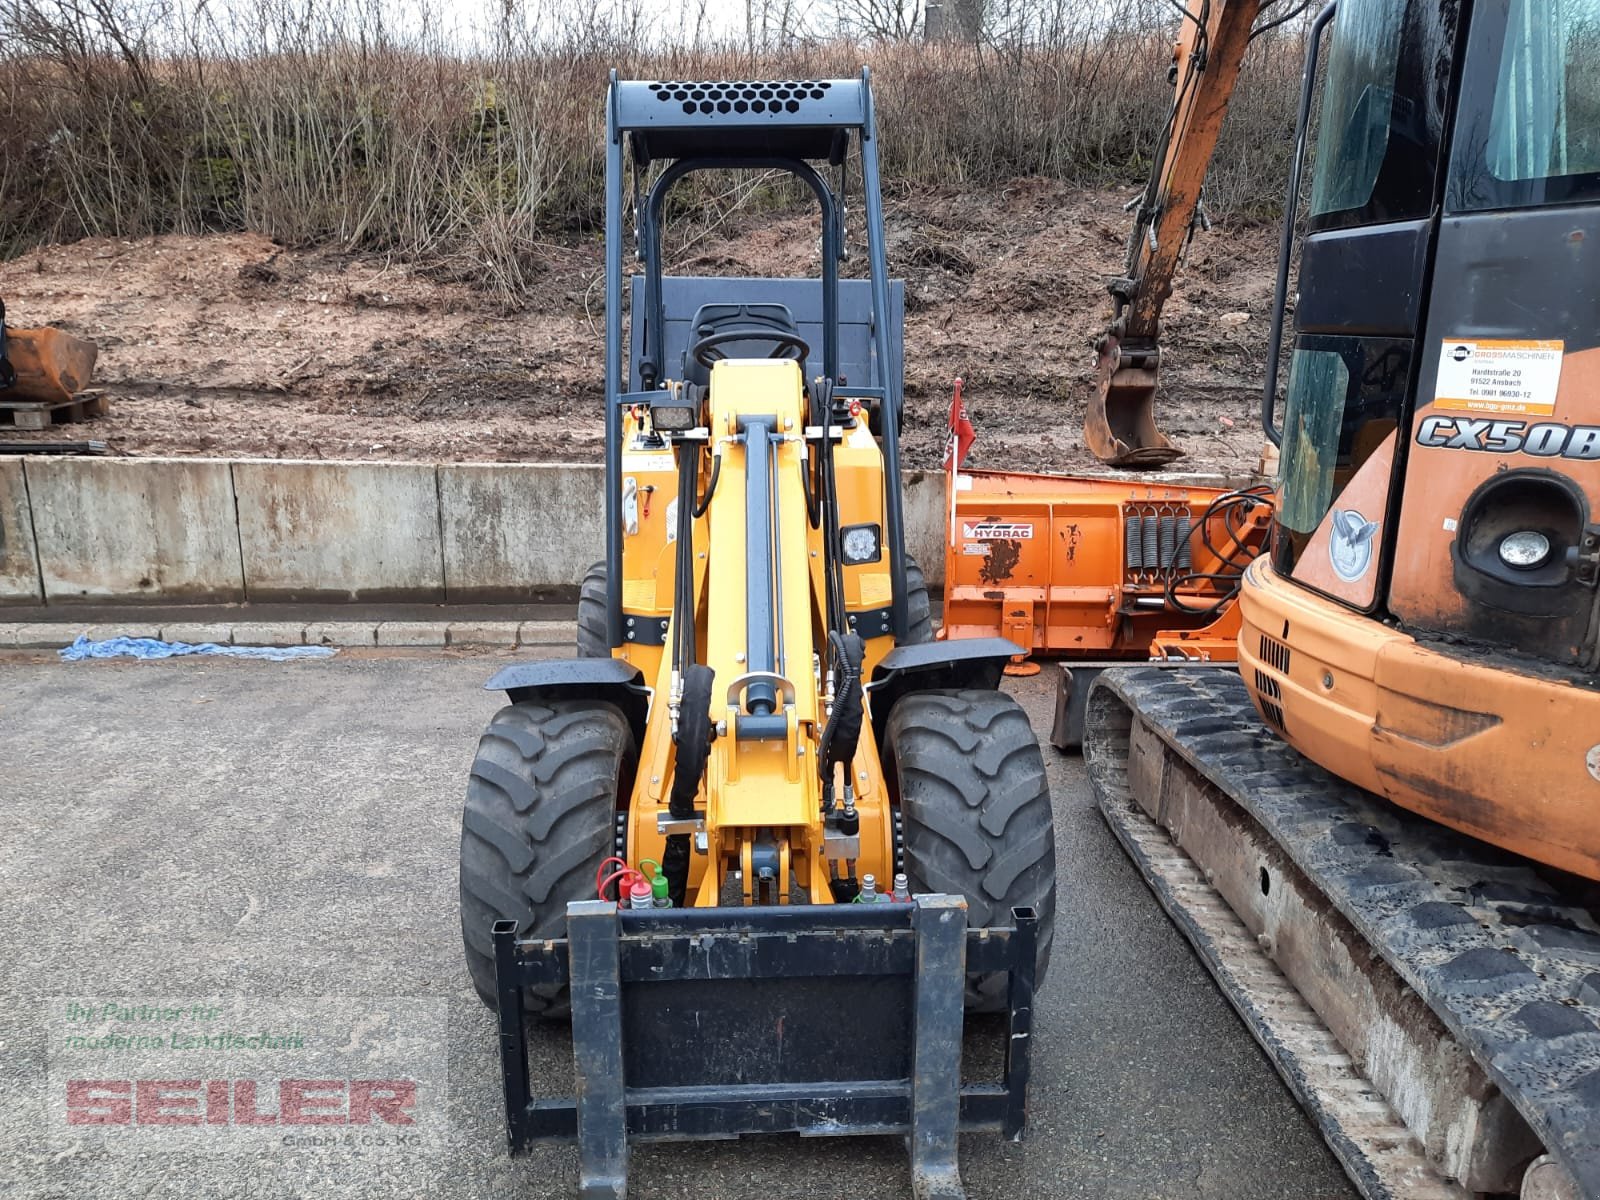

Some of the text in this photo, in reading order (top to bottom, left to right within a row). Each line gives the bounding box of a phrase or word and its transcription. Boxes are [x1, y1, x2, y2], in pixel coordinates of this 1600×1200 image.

[1512, 369, 1522, 377] 20
[1470, 377, 1521, 387] 91522 Ansbach
[1416, 415, 1600, 460] CX50B
